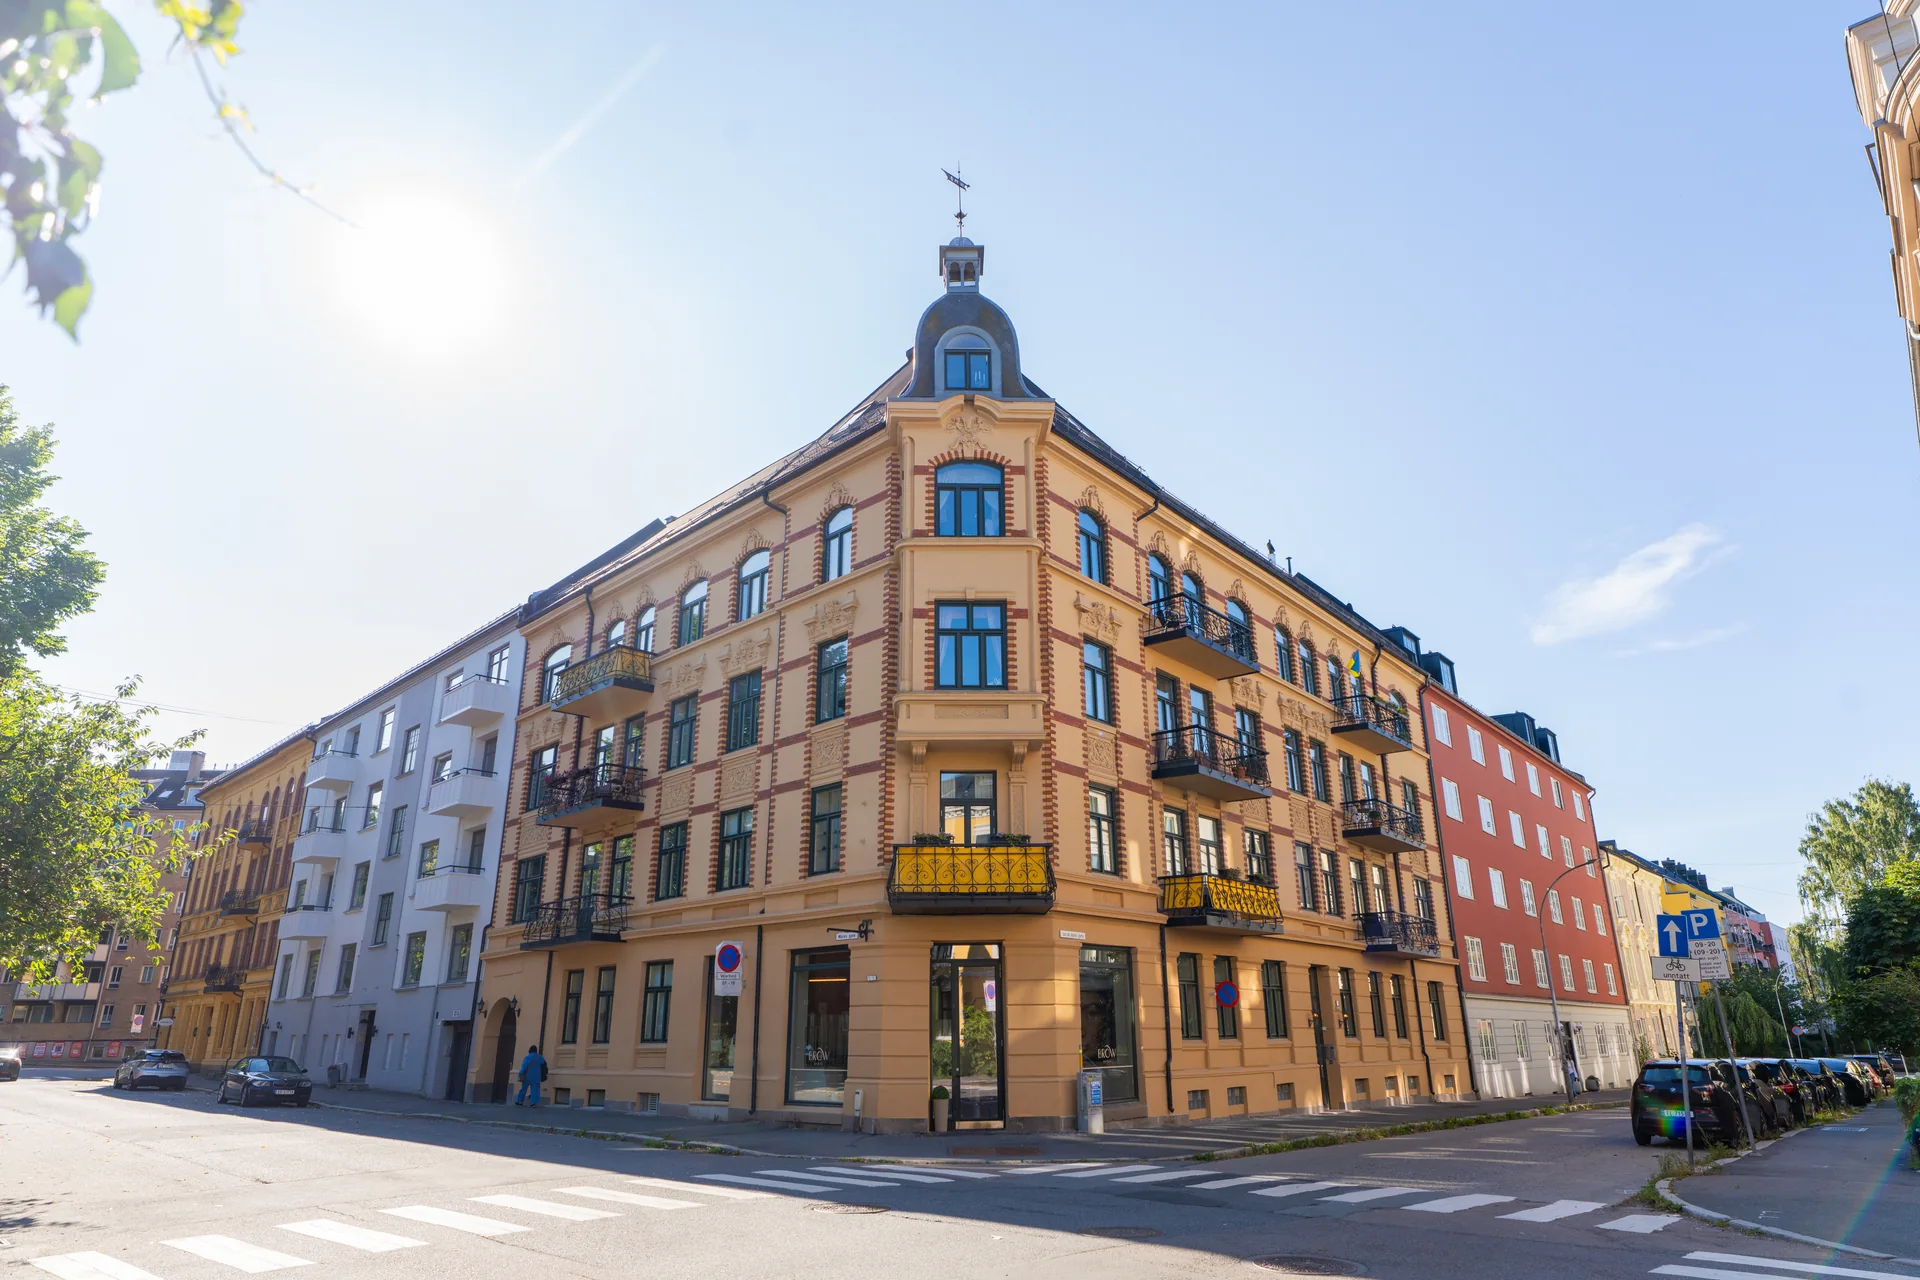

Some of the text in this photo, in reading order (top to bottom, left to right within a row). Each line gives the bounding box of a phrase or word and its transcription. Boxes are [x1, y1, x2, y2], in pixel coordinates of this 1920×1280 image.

[1690, 913, 1708, 936] P
[808, 1046, 830, 1061] BROW
[1097, 1044, 1117, 1059] BROW
